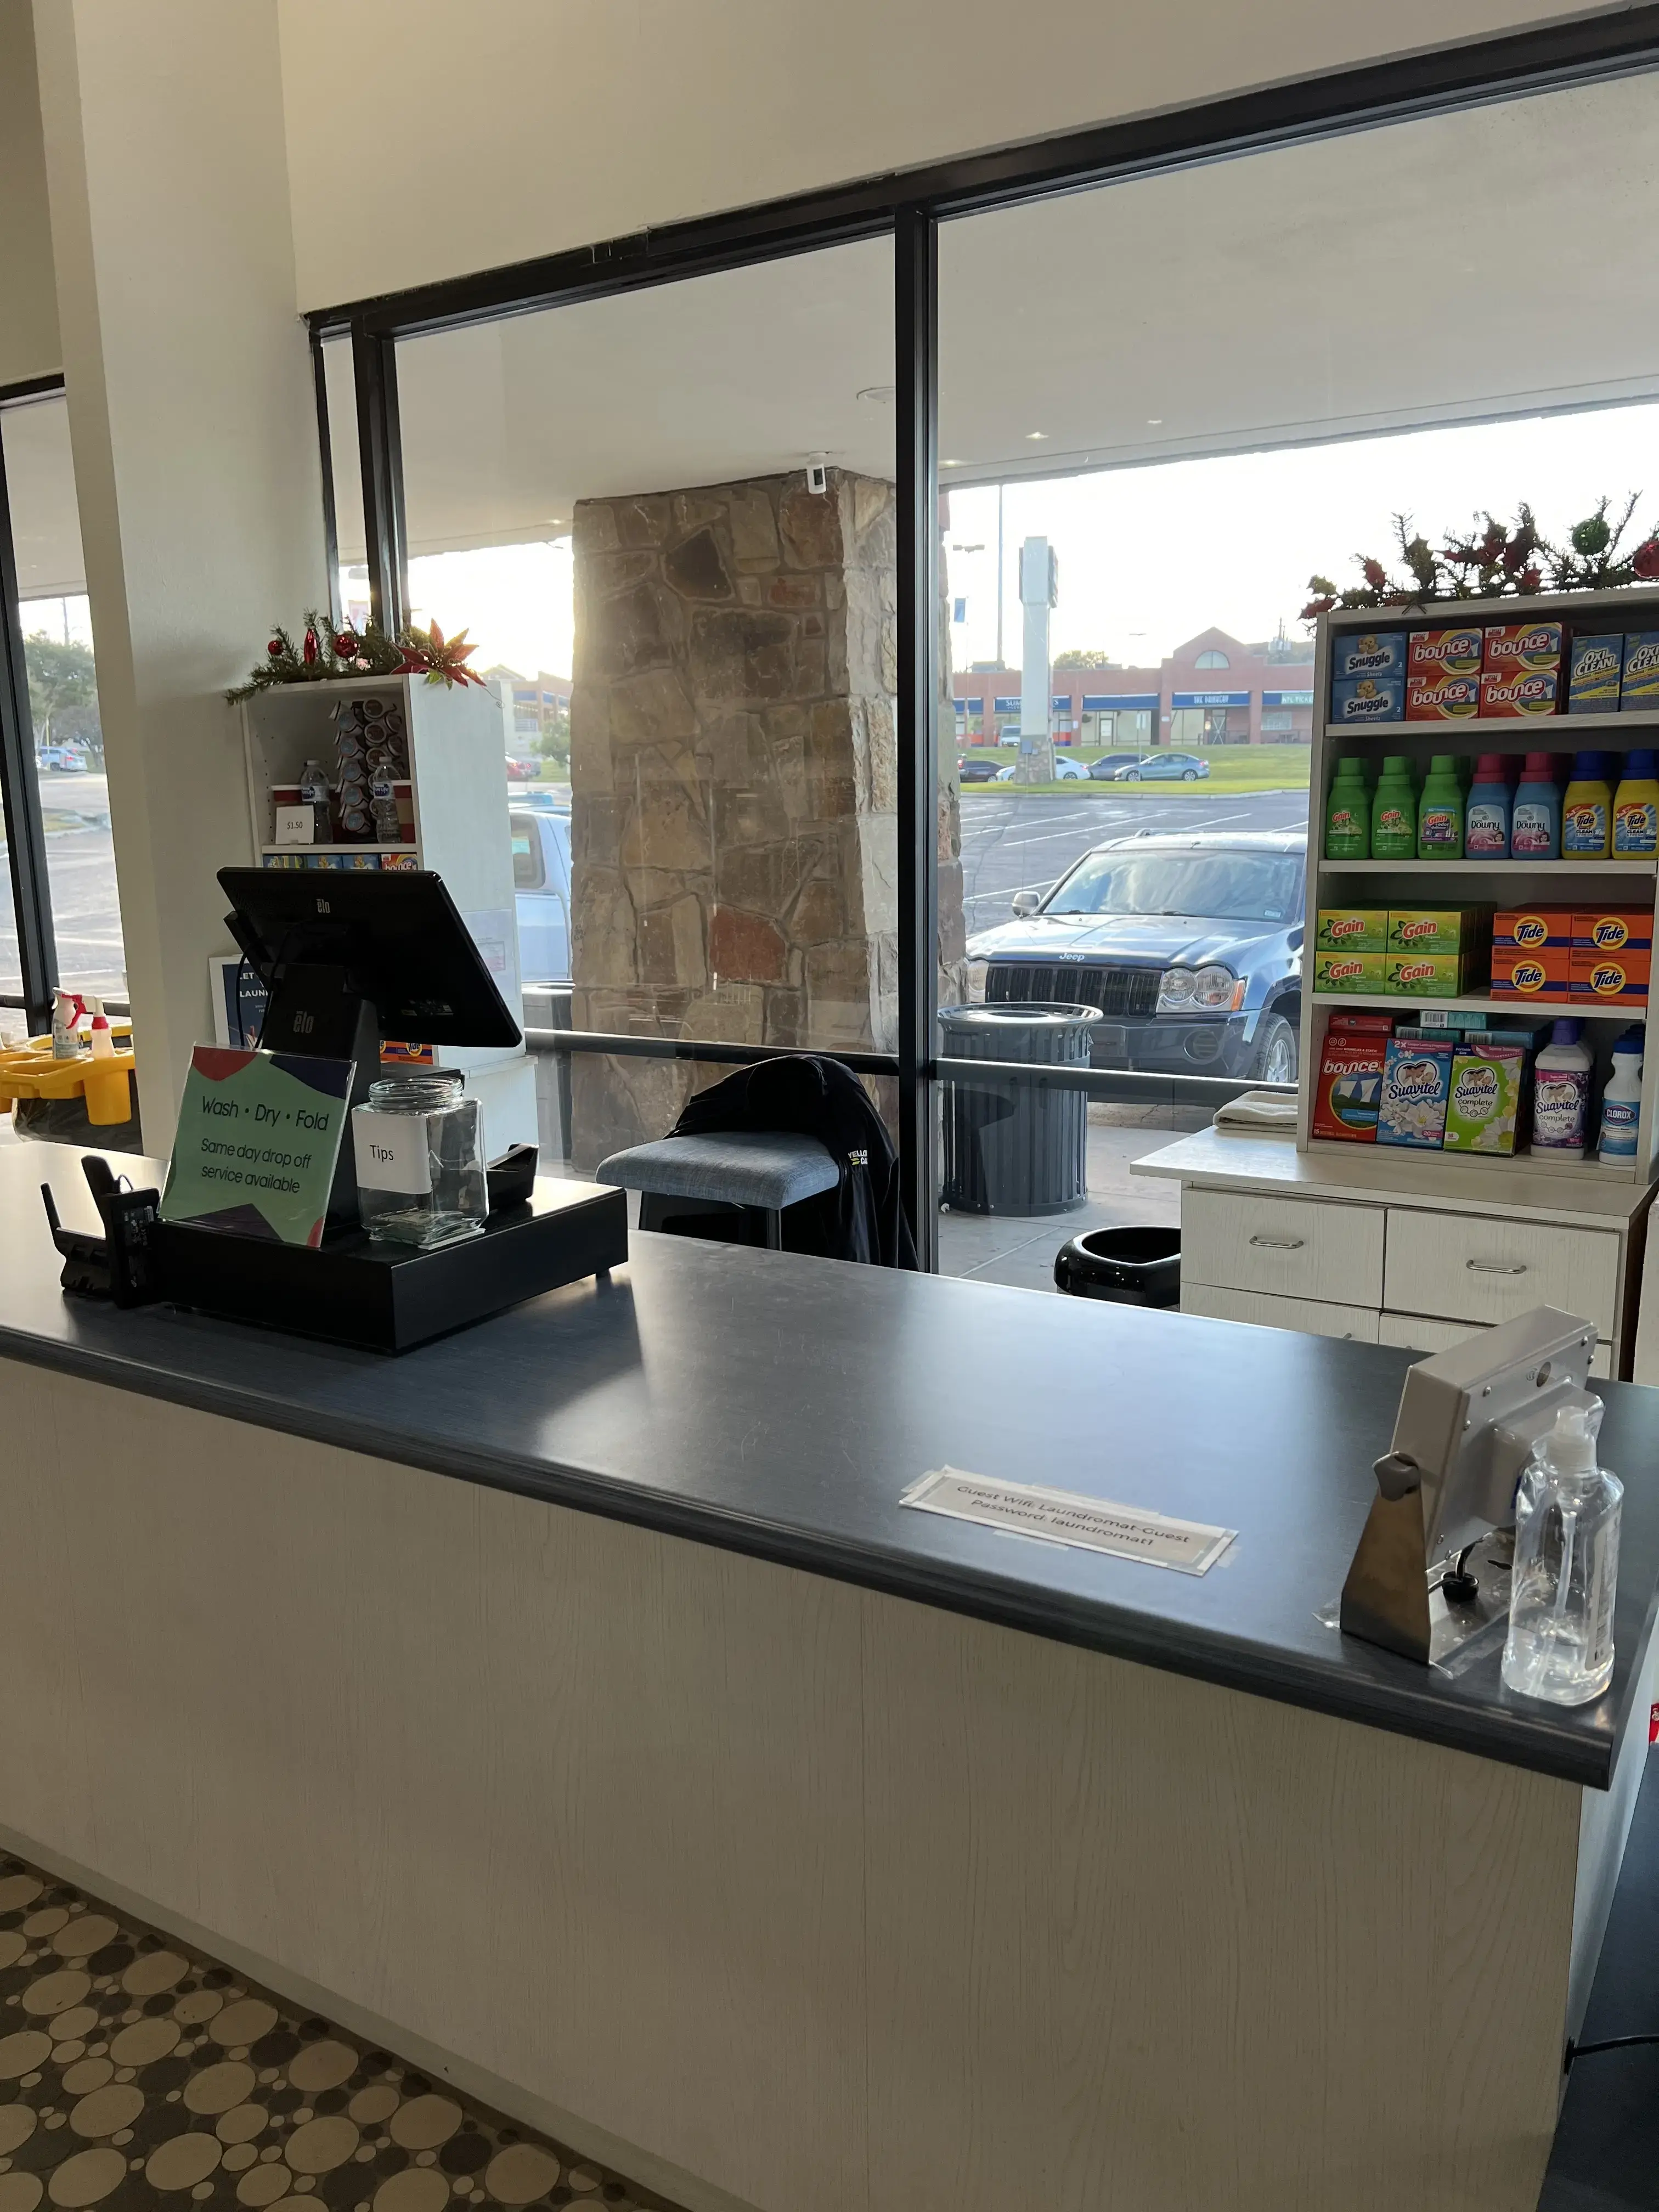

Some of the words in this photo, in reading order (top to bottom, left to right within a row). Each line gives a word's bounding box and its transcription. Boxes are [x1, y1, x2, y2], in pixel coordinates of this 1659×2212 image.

[1414, 638, 1470, 662] bounce
[1489, 633, 1550, 658] bounce
[1348, 652, 1390, 670] Snuggle
[1576, 656, 1614, 676] CLEAN
[1584, 650, 1607, 664] OXI
[1412, 684, 1468, 707] bounce
[1485, 680, 1545, 704] bounce
[1347, 697, 1389, 714] Snuggle
[1333, 811, 1350, 822] Gain
[1381, 810, 1401, 821] Gain
[1427, 814, 1447, 825] Gain
[1577, 814, 1595, 827] Tide
[1627, 814, 1646, 827] Tide
[287, 821, 303, 830] $1.50
[1471, 820, 1500, 831] Downy
[1516, 820, 1545, 831] Downy
[1331, 919, 1365, 938] Gain
[1402, 921, 1438, 939] Gain
[1516, 924, 1544, 943] Tide
[1595, 926, 1625, 944] Tide
[1059, 952, 1085, 962] Jeep
[1329, 962, 1363, 979] Gain
[1400, 964, 1435, 981] Gain
[1515, 968, 1542, 986] Tide
[1594, 970, 1622, 988] Tide
[1323, 1059, 1380, 1075] bounce
[1388, 1081, 1441, 1099] Suavitel
[1455, 1084, 1498, 1098] Suavitel
[202, 1096, 239, 1118] Wash
[255, 1103, 280, 1127] Dry
[296, 1109, 329, 1131] Fold
[1536, 1099, 1579, 1114] Suavitel
[1606, 1109, 1632, 1119] CLOROX
[1539, 1114, 1575, 1123] complete
[201, 1138, 235, 1155] Same
[237, 1144, 261, 1163] day
[262, 1148, 291, 1168] drop
[294, 1154, 312, 1169] off
[369, 1144, 394, 1163] Tips
[201, 1165, 242, 1183] service
[245, 1173, 300, 1193] available
[957, 1486, 1000, 1499] Guest
[1005, 1496, 1036, 1508] Wifi:
[972, 1499, 1047, 1521] Password:
[1051, 1517, 1154, 1545] laundromat1
